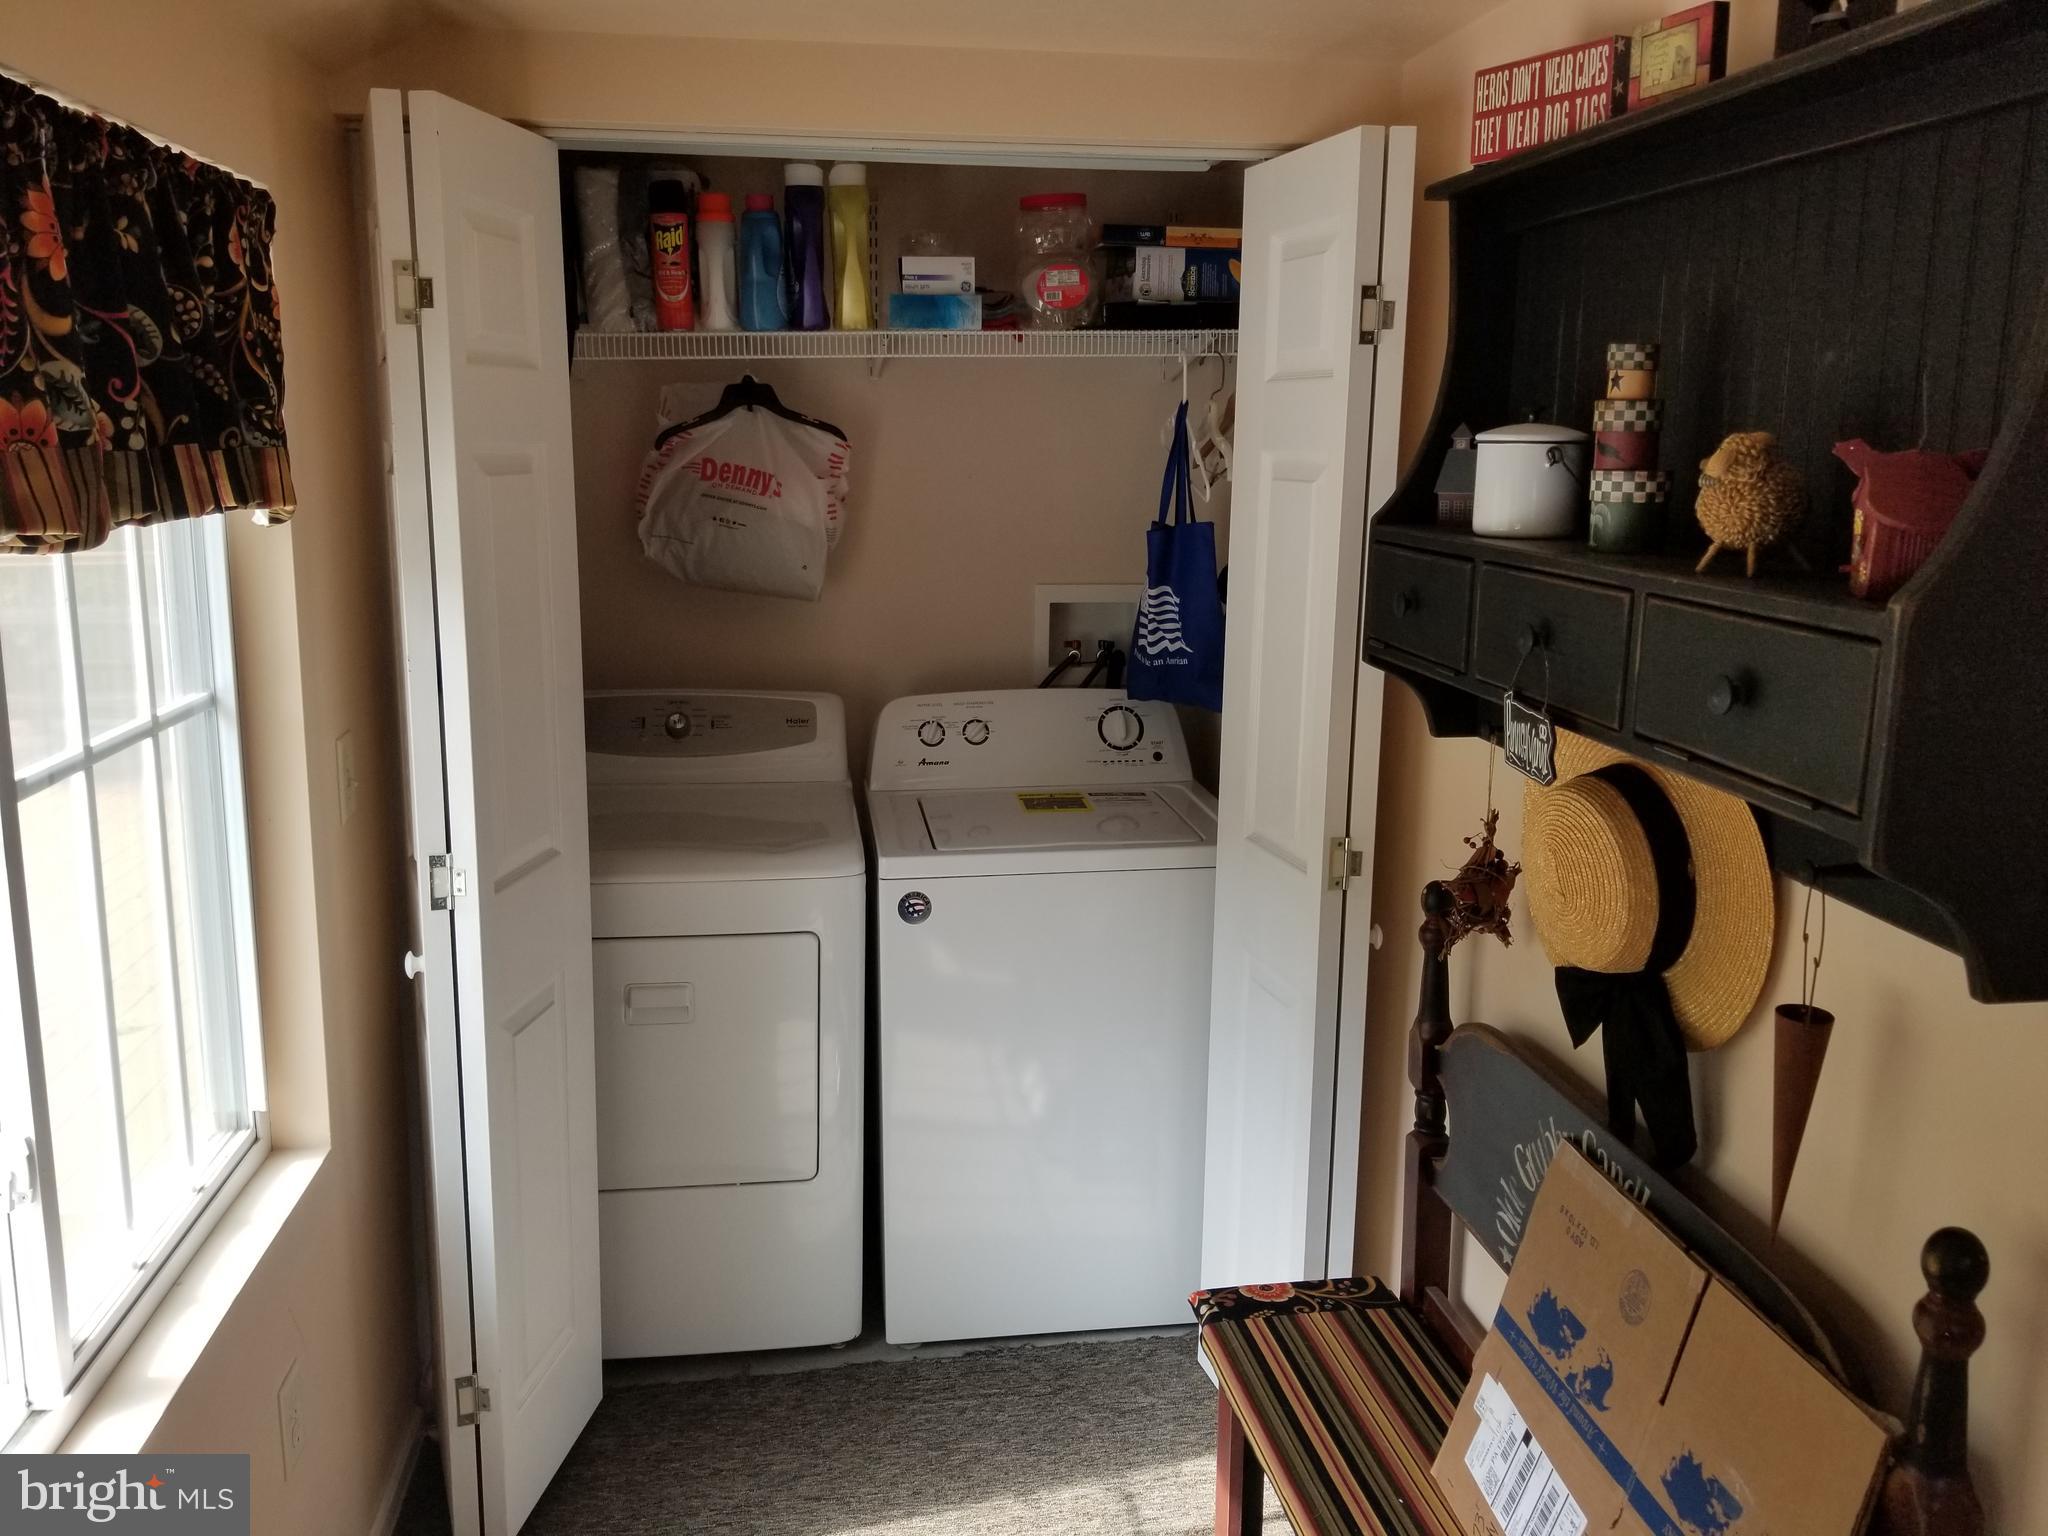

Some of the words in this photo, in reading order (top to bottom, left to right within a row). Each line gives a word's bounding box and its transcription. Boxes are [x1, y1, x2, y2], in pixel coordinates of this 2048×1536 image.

[1476, 69, 1510, 114] HEROS
[1511, 61, 1541, 105] DON'T
[1545, 53, 1574, 98] WEAR
[1575, 44, 1609, 91] CAPES
[1474, 115, 1502, 157] THEY
[1507, 107, 1540, 151] WEAR
[1544, 100, 1570, 143] DOG
[1576, 92, 1607, 132] TAGS
[655, 224, 684, 251] Raid
[700, 457, 782, 498] Denny's
[786, 717, 810, 725] Haier
[918, 758, 950, 767] Amana
[1514, 1116, 1574, 1192] Grubb
